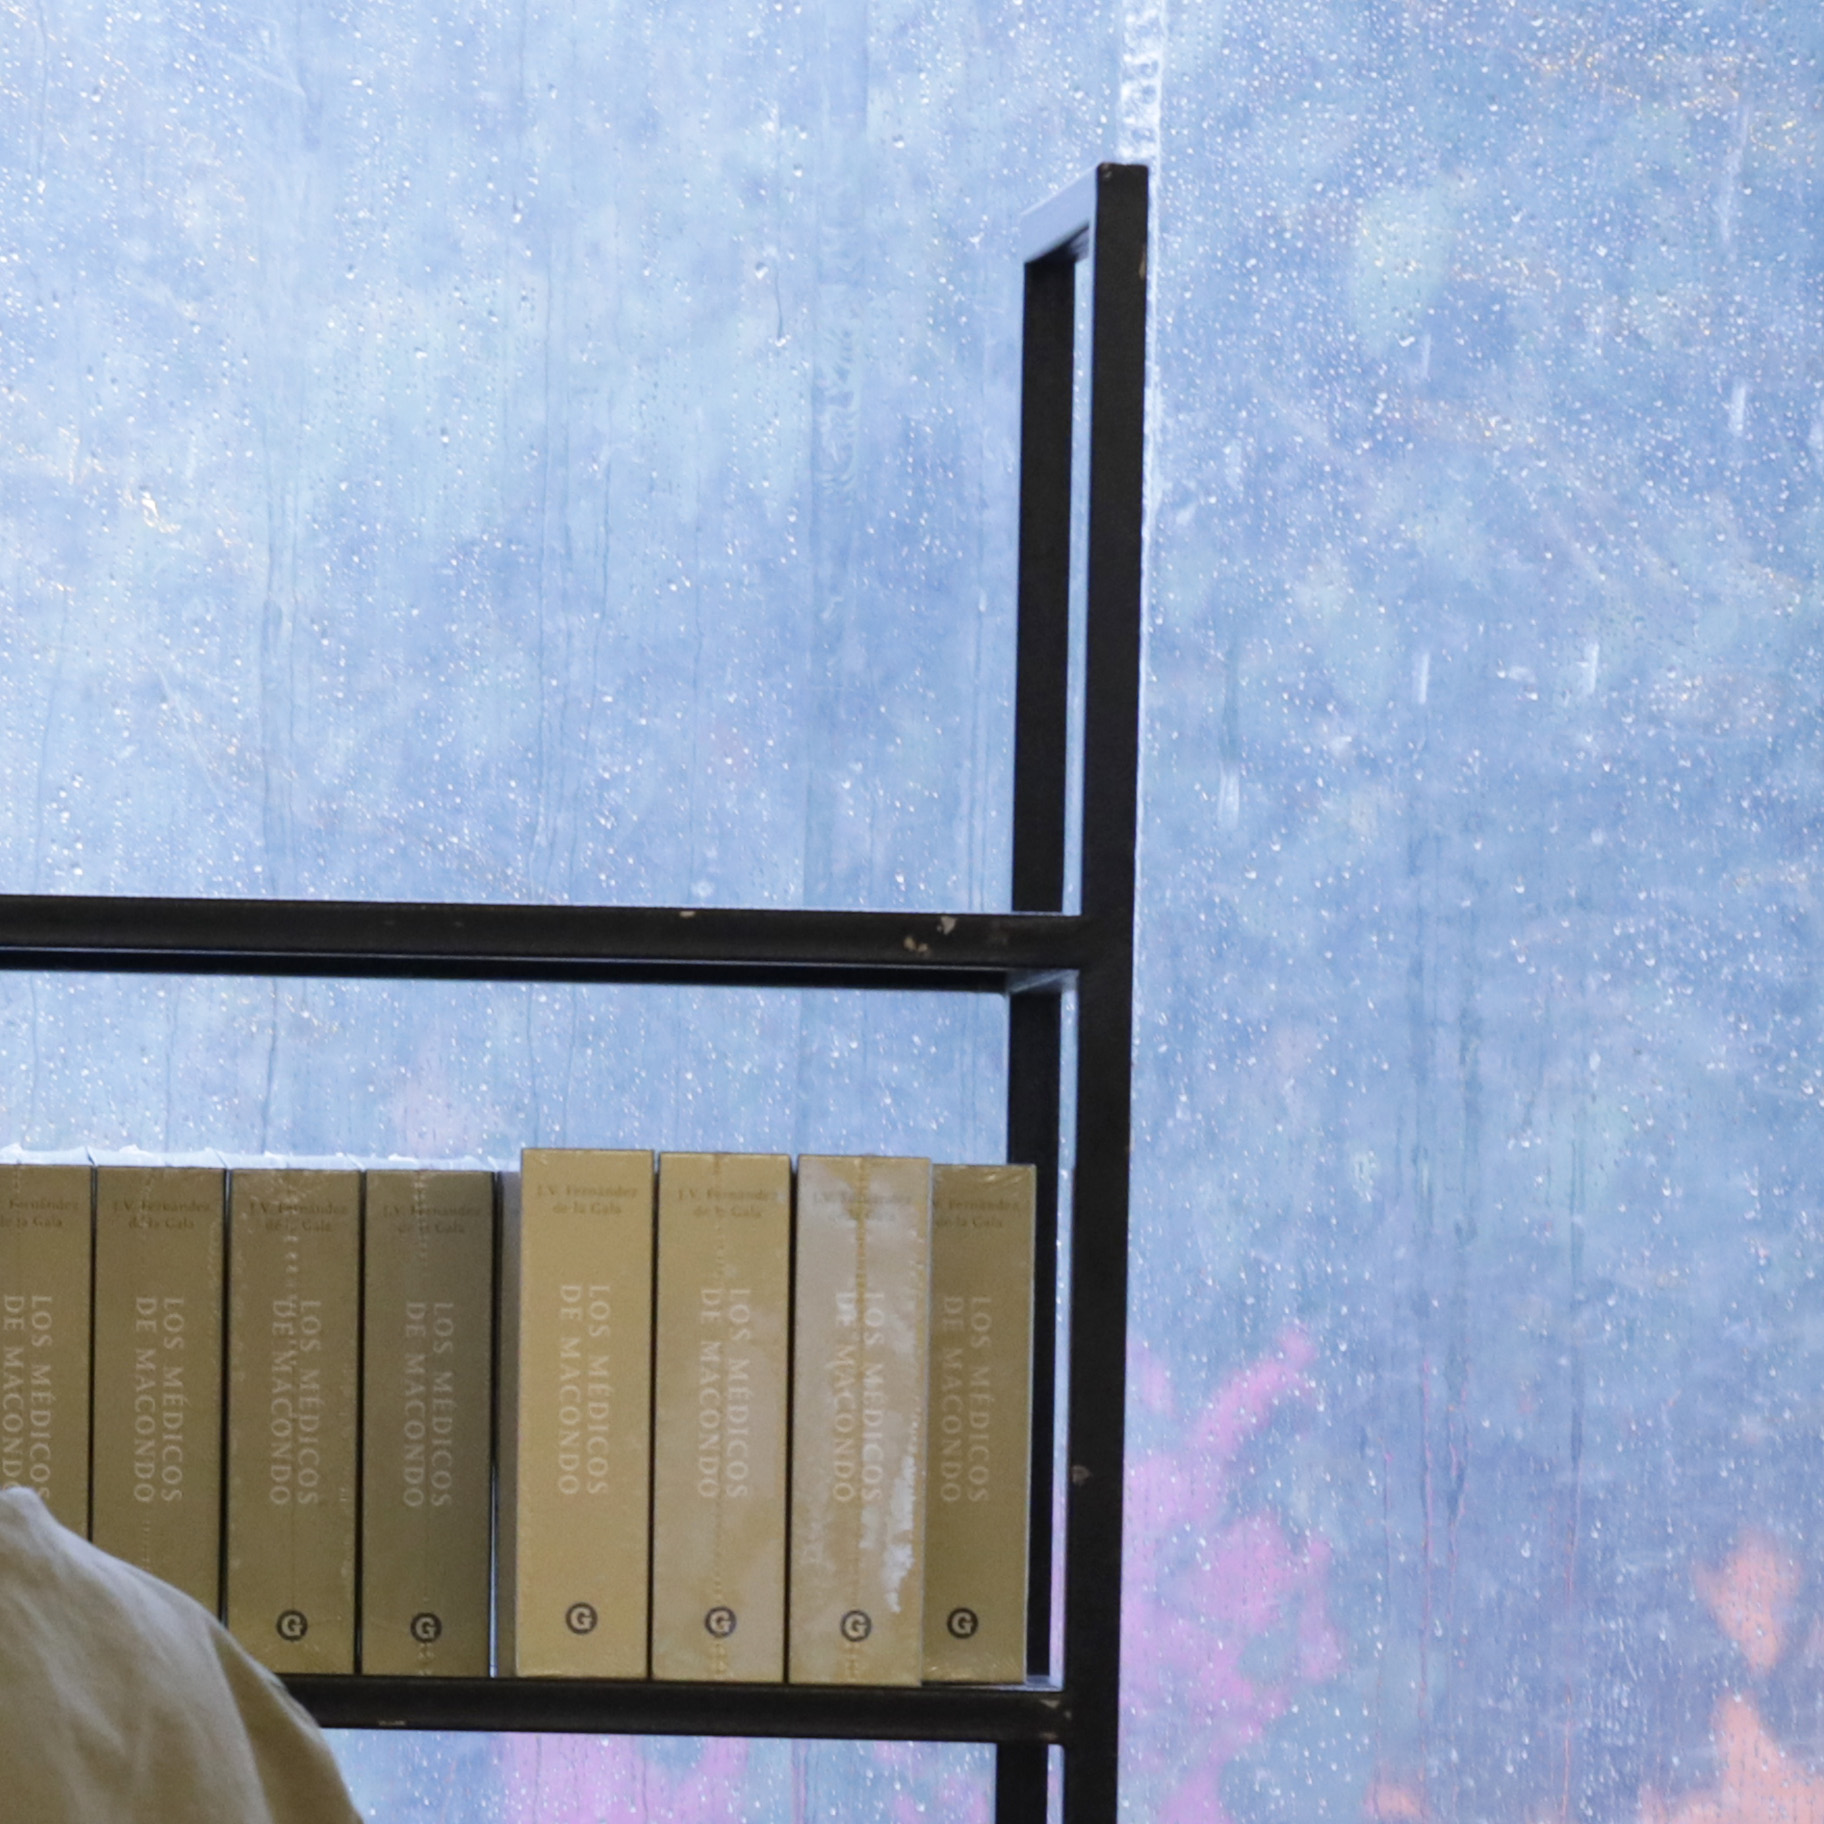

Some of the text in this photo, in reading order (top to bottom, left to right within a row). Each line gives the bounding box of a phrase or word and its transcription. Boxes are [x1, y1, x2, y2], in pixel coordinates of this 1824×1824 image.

[133, 1296, 158, 1504] DE MACONDO
[163, 1297, 185, 1349] LOS
[269, 1299, 296, 1507] DE MACONDO
[299, 1299, 322, 1353] LOS
[402, 1303, 427, 1509] DE MACONDO
[433, 1303, 455, 1356] LOS
[558, 1283, 584, 1497] DE MACONDO
[585, 1284, 612, 1496] LOS MÉDICOS
[697, 1288, 723, 1500] DE MACONDO
[728, 1288, 751, 1343] LOS
[832, 1291, 859, 1504] DE MACONDO
[863, 1291, 886, 1345] LOS
[940, 1295, 965, 1505] DE MACONDO
[969, 1296, 992, 1350] LOS
